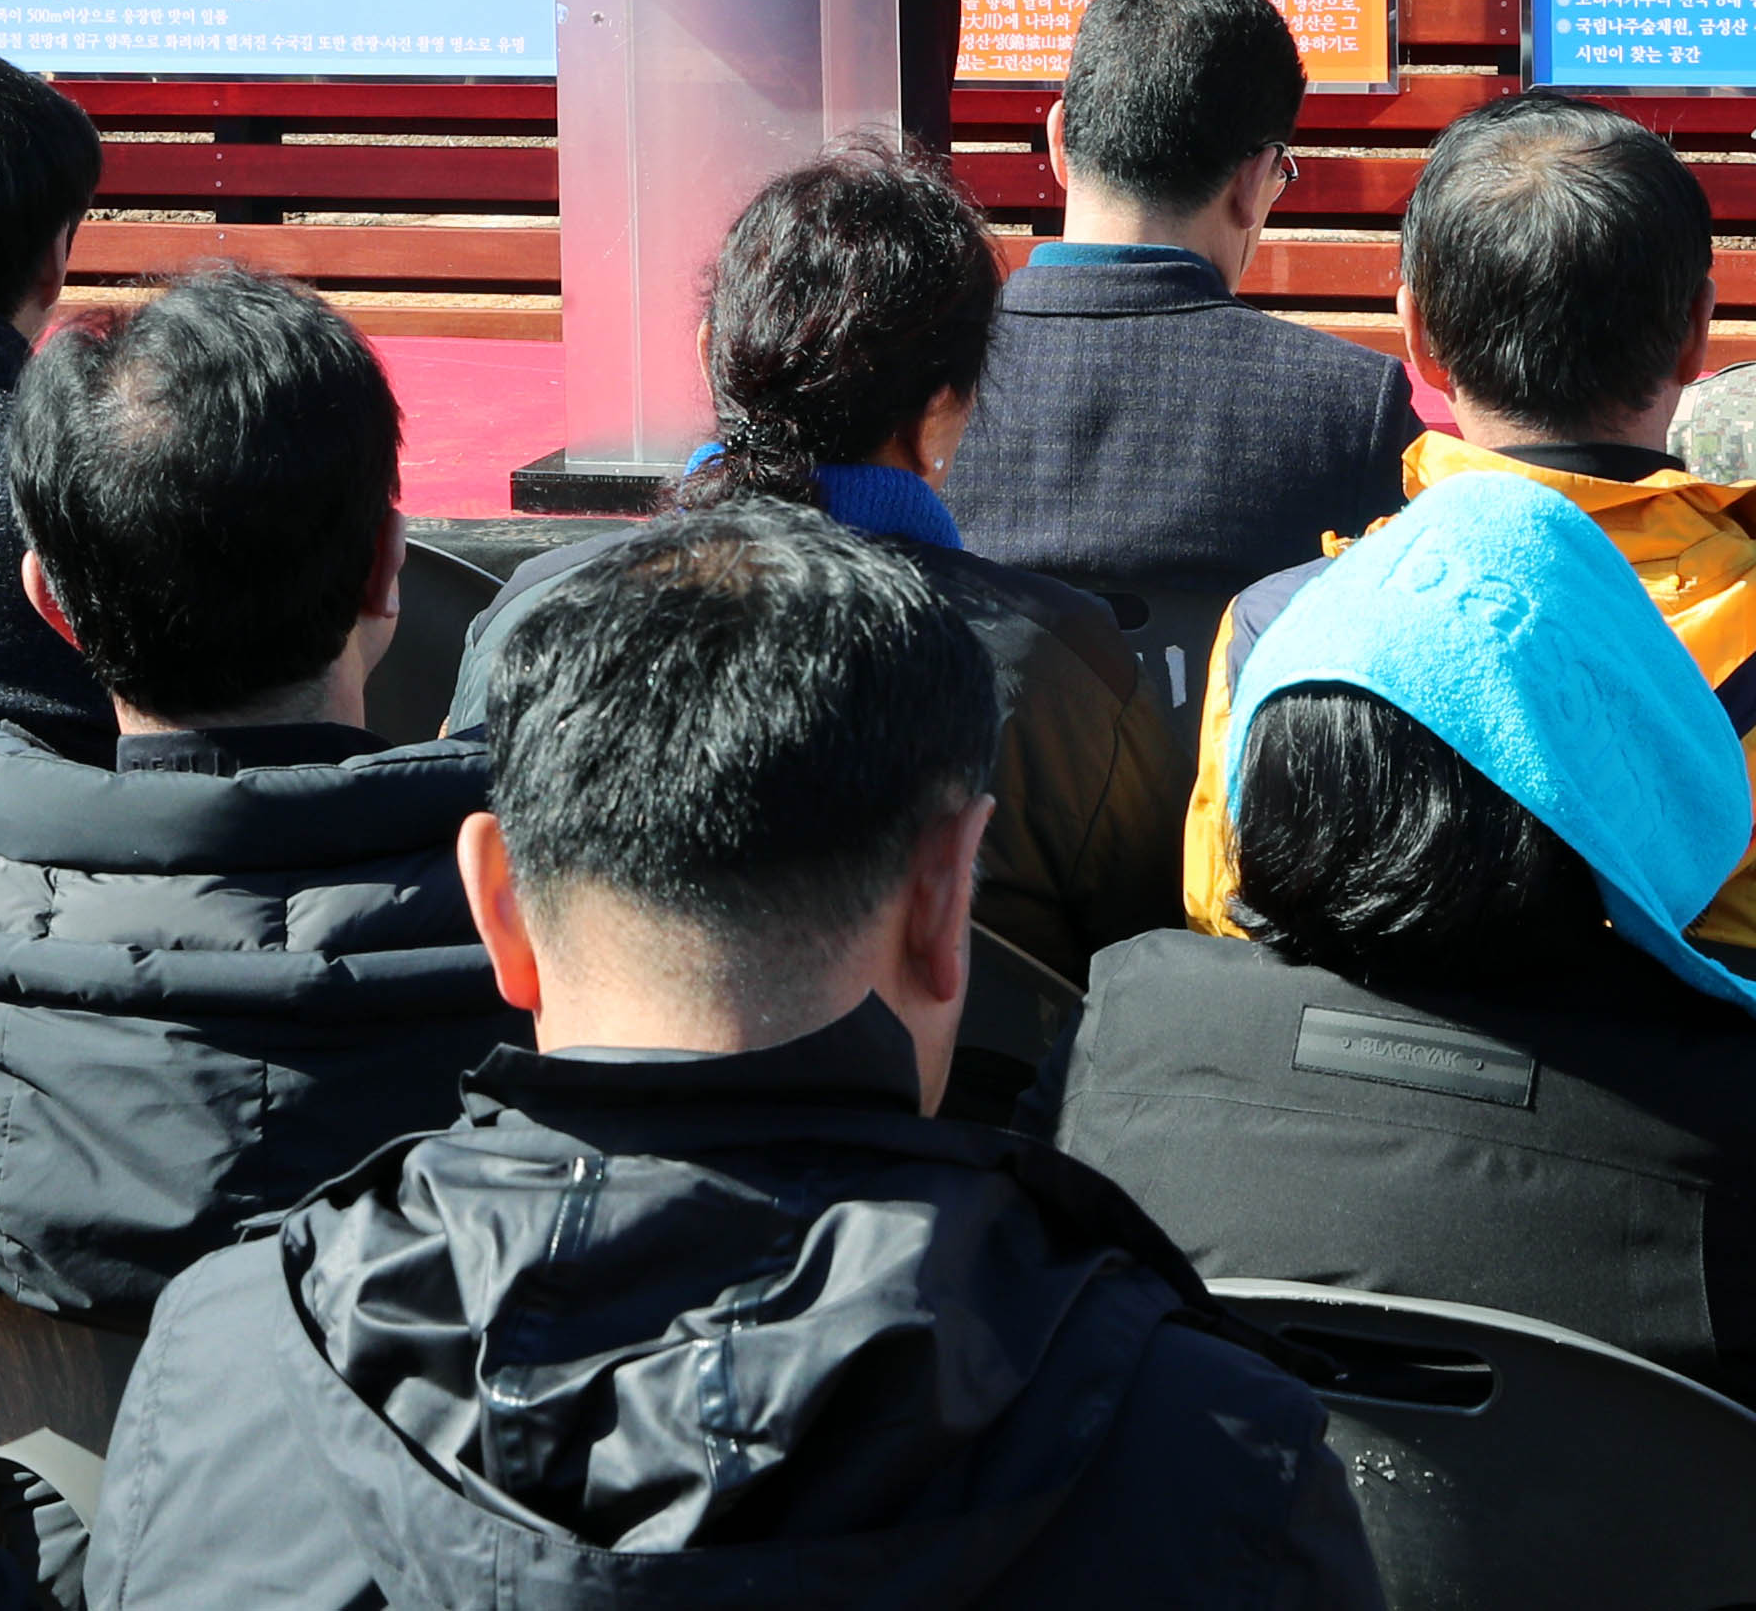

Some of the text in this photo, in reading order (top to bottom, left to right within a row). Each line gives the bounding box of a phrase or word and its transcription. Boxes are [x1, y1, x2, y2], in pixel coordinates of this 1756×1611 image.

[960, 12, 1359, 32] 大川)에 나라와 성산은 그
[1575, 18, 1693, 36] 국립나주숲체원,
[1699, 19, 1748, 37] 금성산
[1297, 35, 1360, 53] 용하기도
[988, 54, 1071, 73] 그런산이었
[1575, 45, 1701, 64] 시민이 찾는 공간
